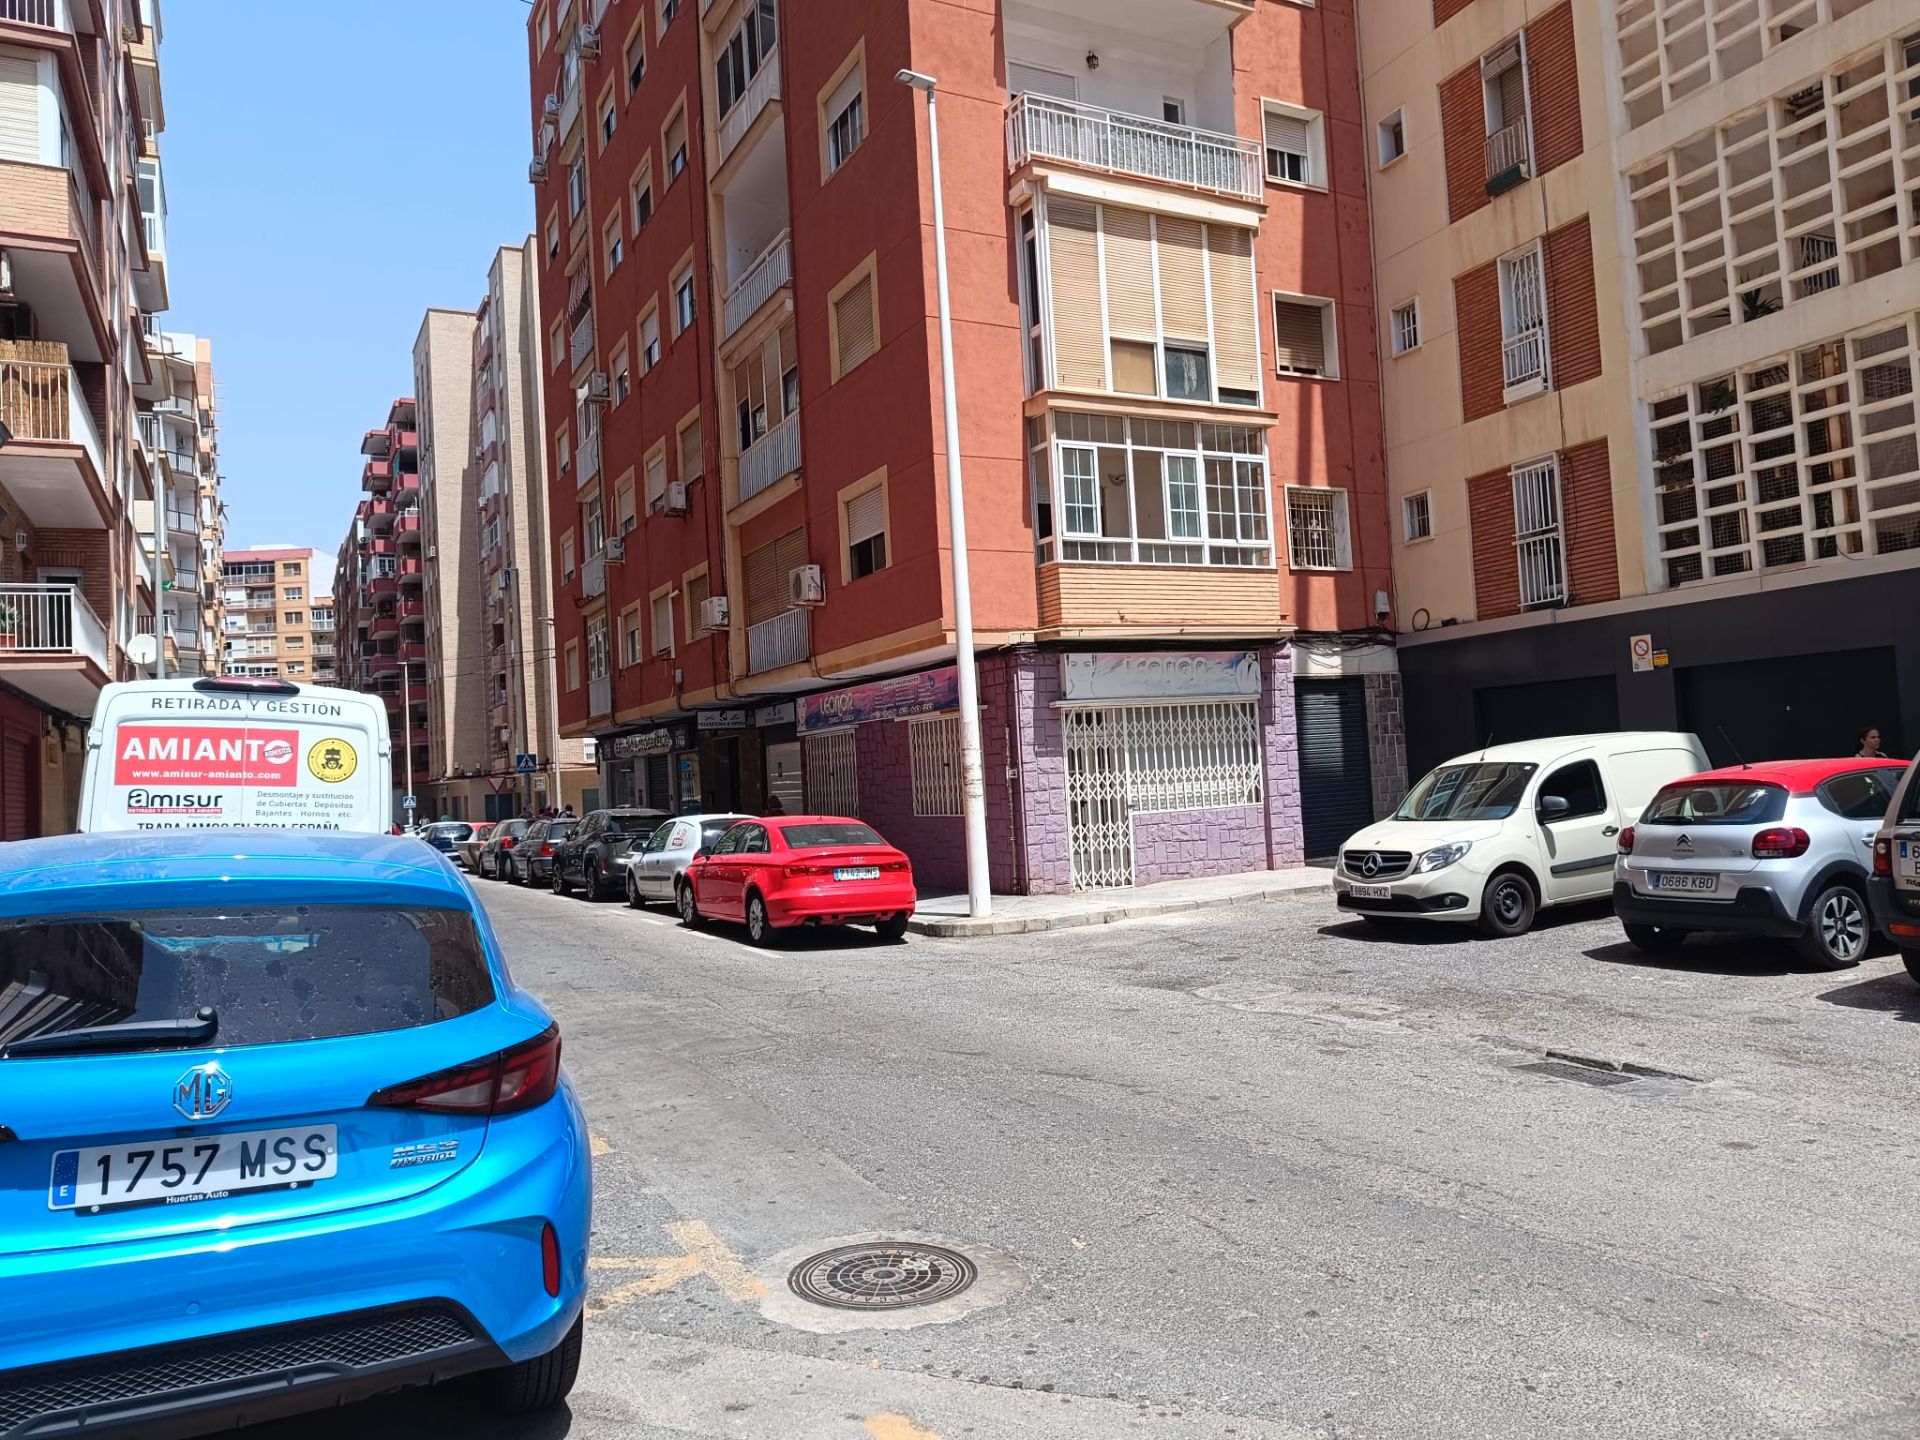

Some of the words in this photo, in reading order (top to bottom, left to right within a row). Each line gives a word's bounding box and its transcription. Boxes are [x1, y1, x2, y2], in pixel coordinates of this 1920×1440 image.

[151, 697, 242, 711] RETIRADA
[250, 699, 259, 711] Y
[266, 701, 341, 716] GESTIÓN
[122, 737, 293, 765] AMIANTO
[132, 769, 281, 780] www.amisur-amianto.com
[128, 788, 223, 808] amisur
[257, 790, 304, 800] Desmontaje
[255, 809, 292, 818] Bajantes
[300, 810, 330, 818] Hornos
[1661, 875, 1688, 888] 0686
[1690, 876, 1714, 890] KBD
[177, 1068, 229, 1116] MG
[97, 1144, 221, 1196] 1757
[240, 1133, 327, 1180] MSS
[59, 1184, 68, 1197] E
[166, 1191, 203, 1204] Huertas
[206, 1189, 229, 1200] Auto
